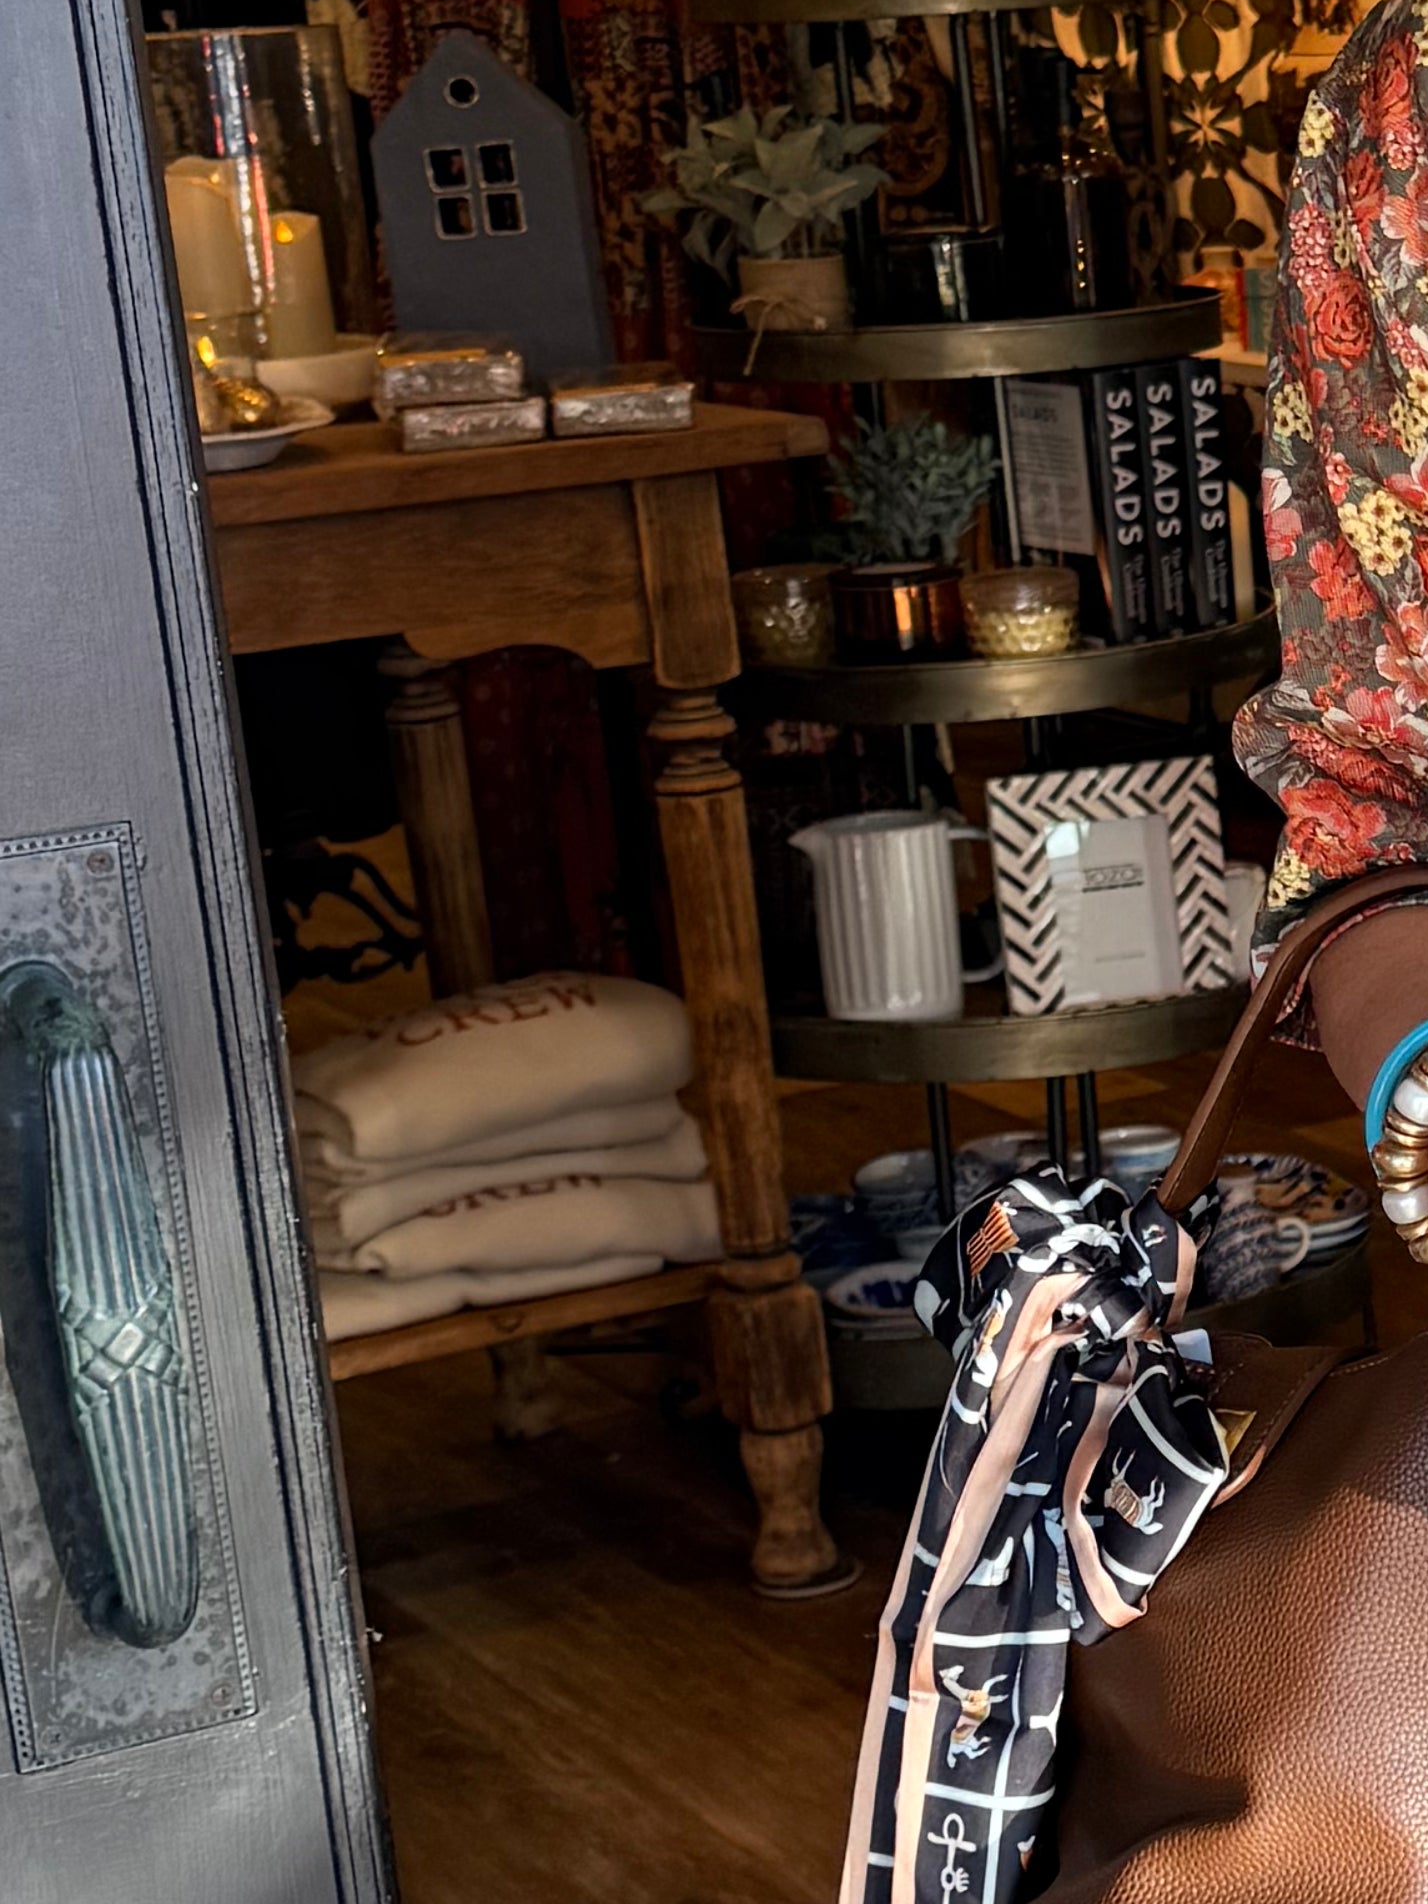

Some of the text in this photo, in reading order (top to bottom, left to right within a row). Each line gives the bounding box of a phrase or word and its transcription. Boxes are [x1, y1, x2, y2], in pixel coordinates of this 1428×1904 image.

[1106, 389, 1144, 546] SALADS
[1146, 383, 1182, 539] SALADS
[1190, 374, 1226, 531] SALADS
